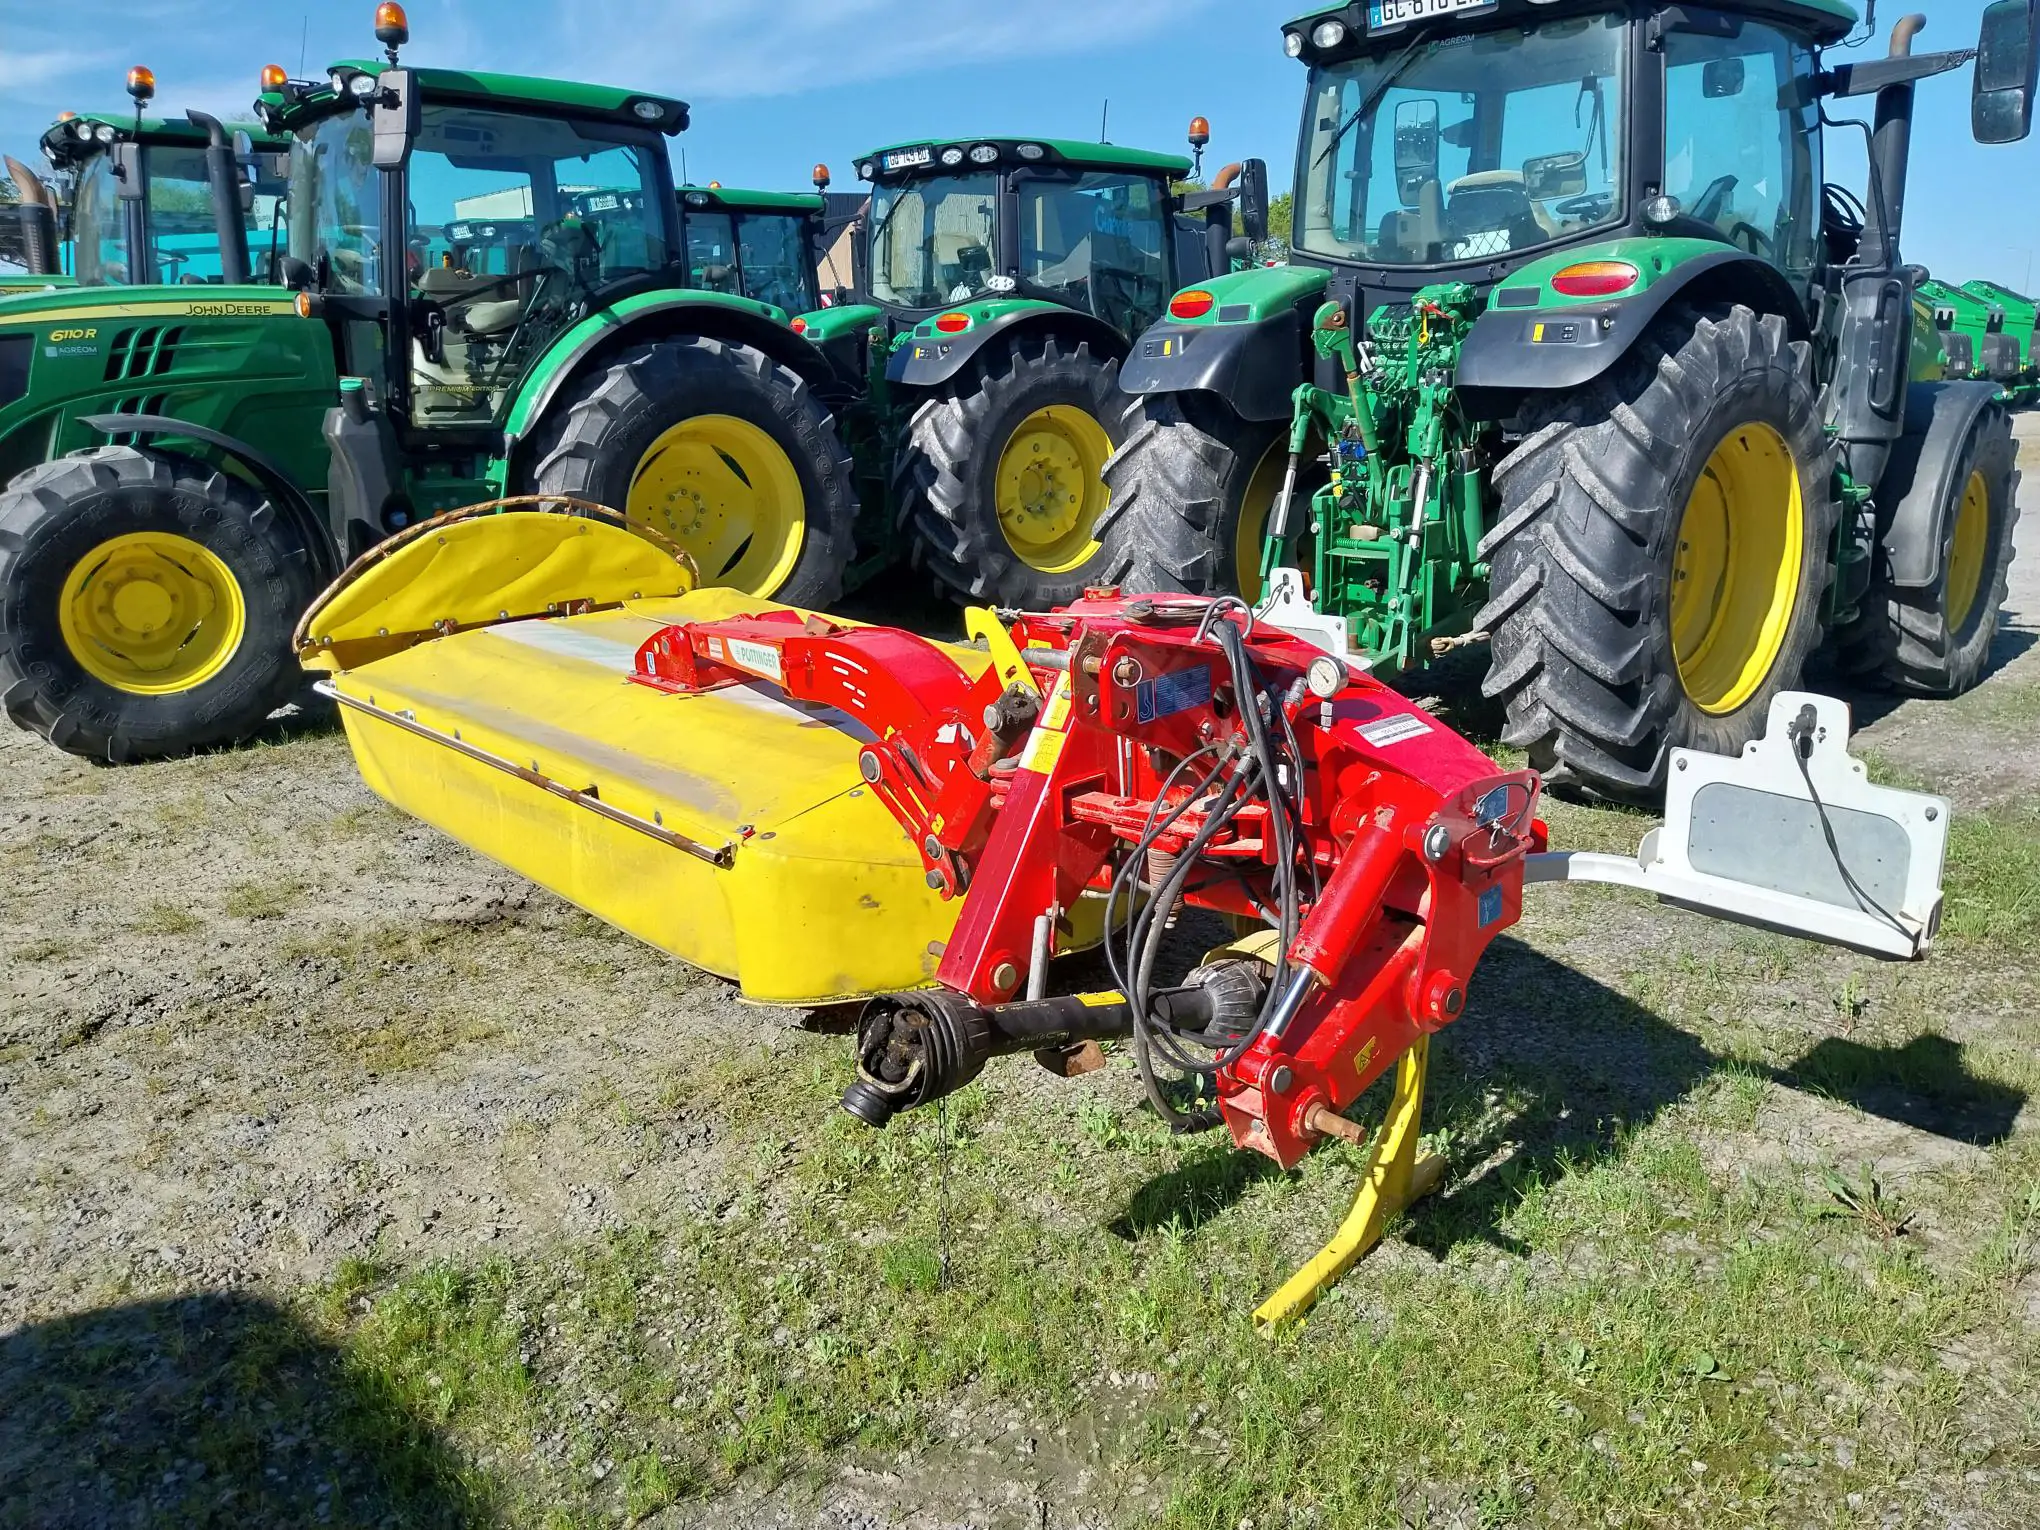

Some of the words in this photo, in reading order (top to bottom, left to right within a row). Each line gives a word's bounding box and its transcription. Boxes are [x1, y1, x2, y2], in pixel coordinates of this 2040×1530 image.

[1440, 33, 1475, 47] AGREOM
[186, 304, 223, 315] JOHN
[225, 303, 271, 314] DEERE
[59, 346, 97, 354] AGREOM
[429, 385, 469, 393] PREMIUM
